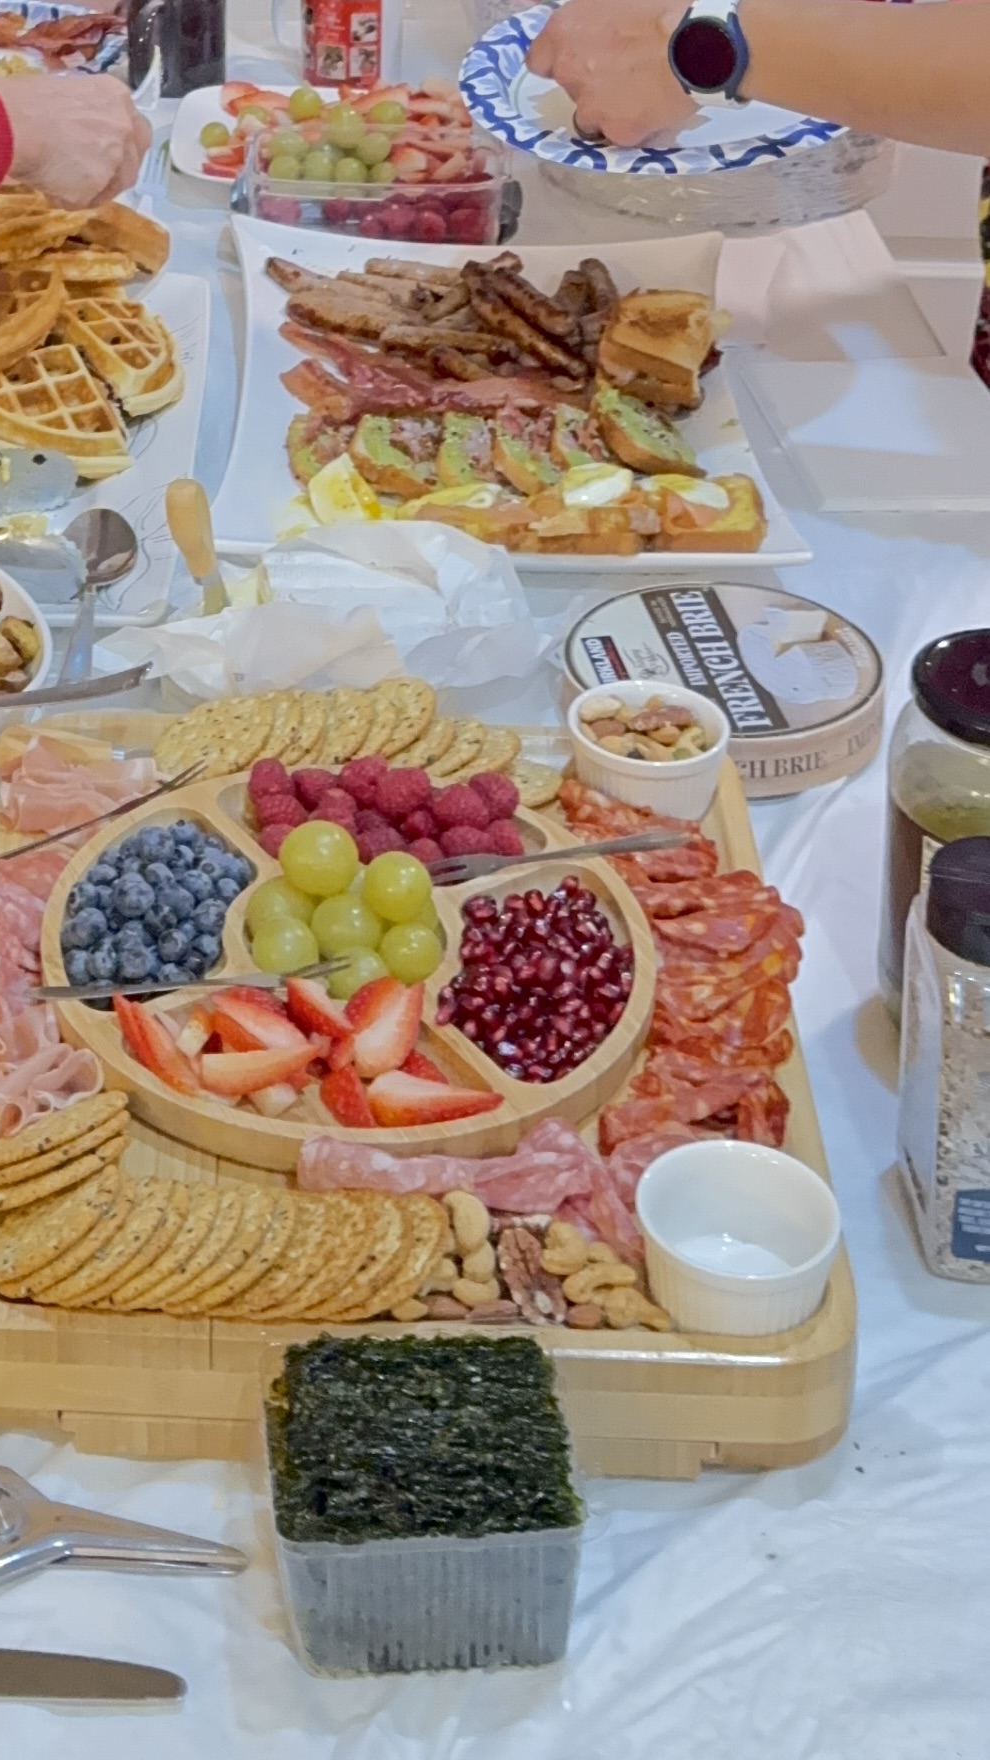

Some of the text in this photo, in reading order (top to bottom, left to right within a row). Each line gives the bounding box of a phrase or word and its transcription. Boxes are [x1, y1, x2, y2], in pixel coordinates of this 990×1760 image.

[669, 590, 725, 638] BRIE
[584, 638, 618, 683] IRKLAND
[666, 632, 708, 686] IMPORTED
[694, 639, 773, 730] FRENCH
[774, 748, 828, 777] BRIE
